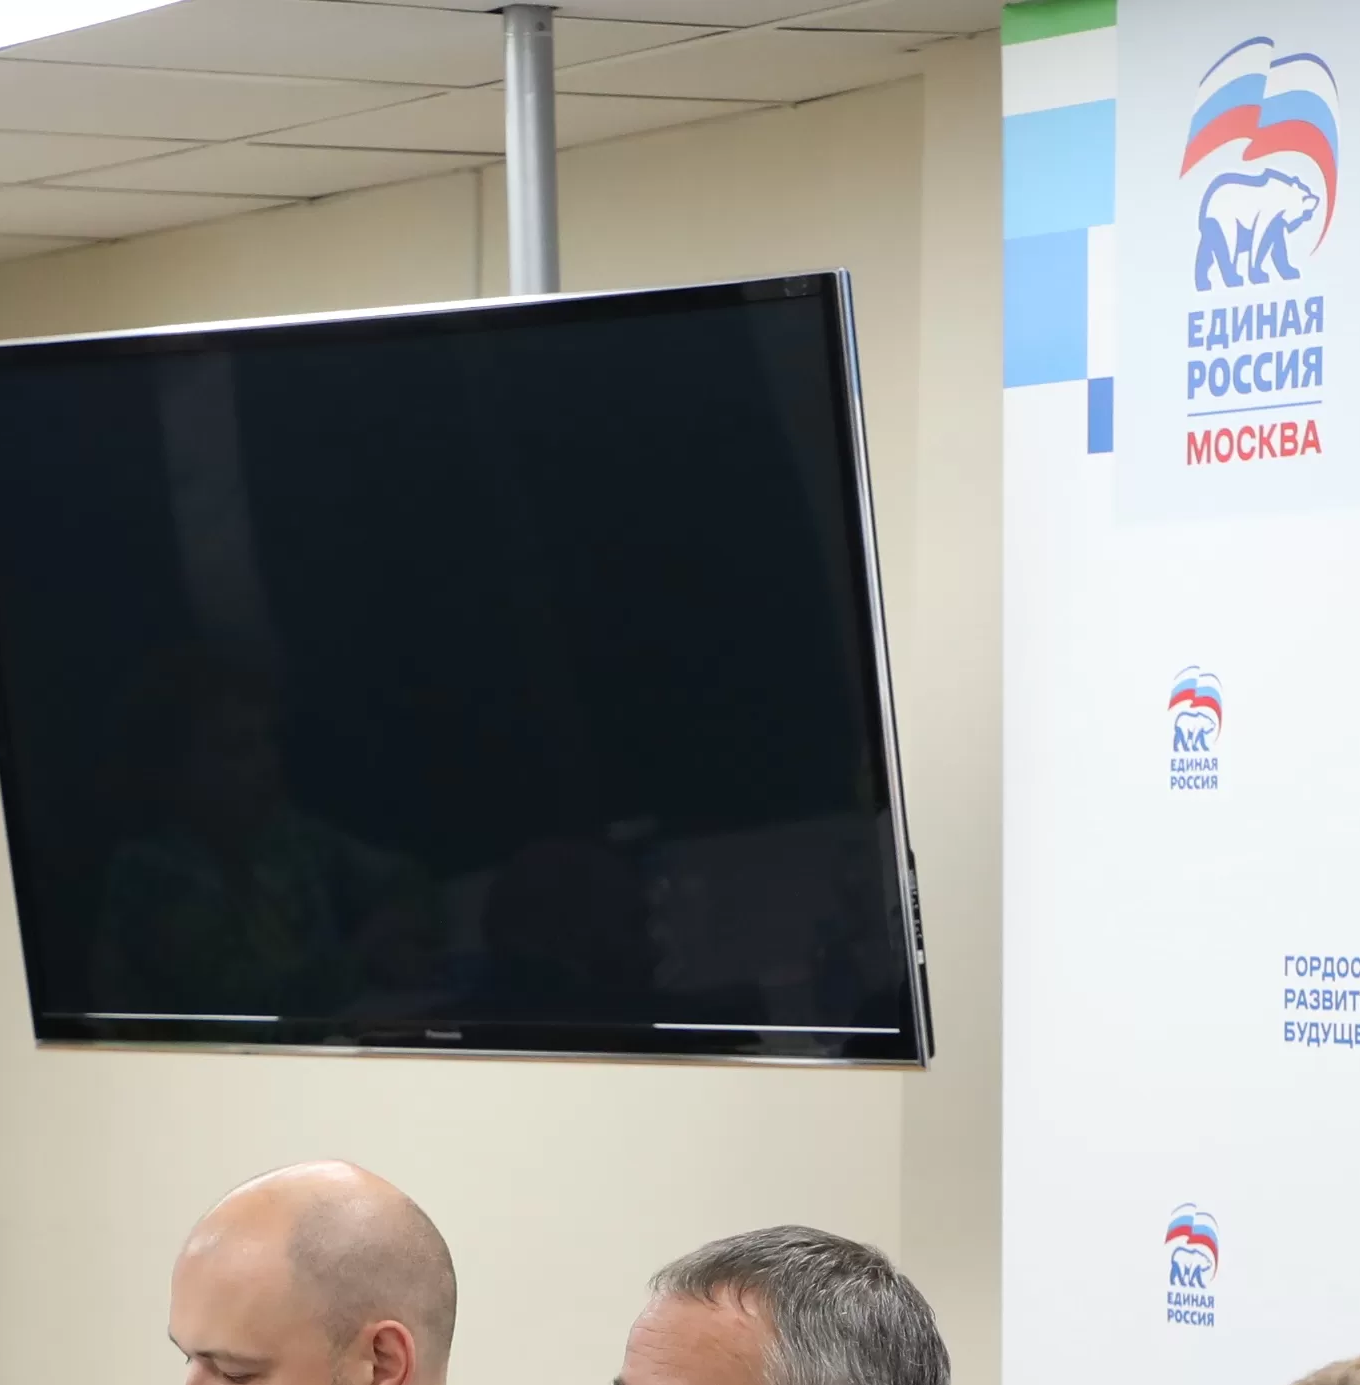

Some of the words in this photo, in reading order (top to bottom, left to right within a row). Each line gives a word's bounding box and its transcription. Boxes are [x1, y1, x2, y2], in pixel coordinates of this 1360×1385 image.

[1188, 294, 1325, 351] ЕДИНАЯ
[1187, 345, 1324, 400] РОССИЯ
[1186, 419, 1323, 466] МОСКВА
[1169, 757, 1220, 772] ЕДИНАЯ
[1169, 774, 1219, 790] РОССИЯ
[1167, 1290, 1216, 1307] ЕДИНАЯ
[1167, 1307, 1216, 1326] РОССИЯ
